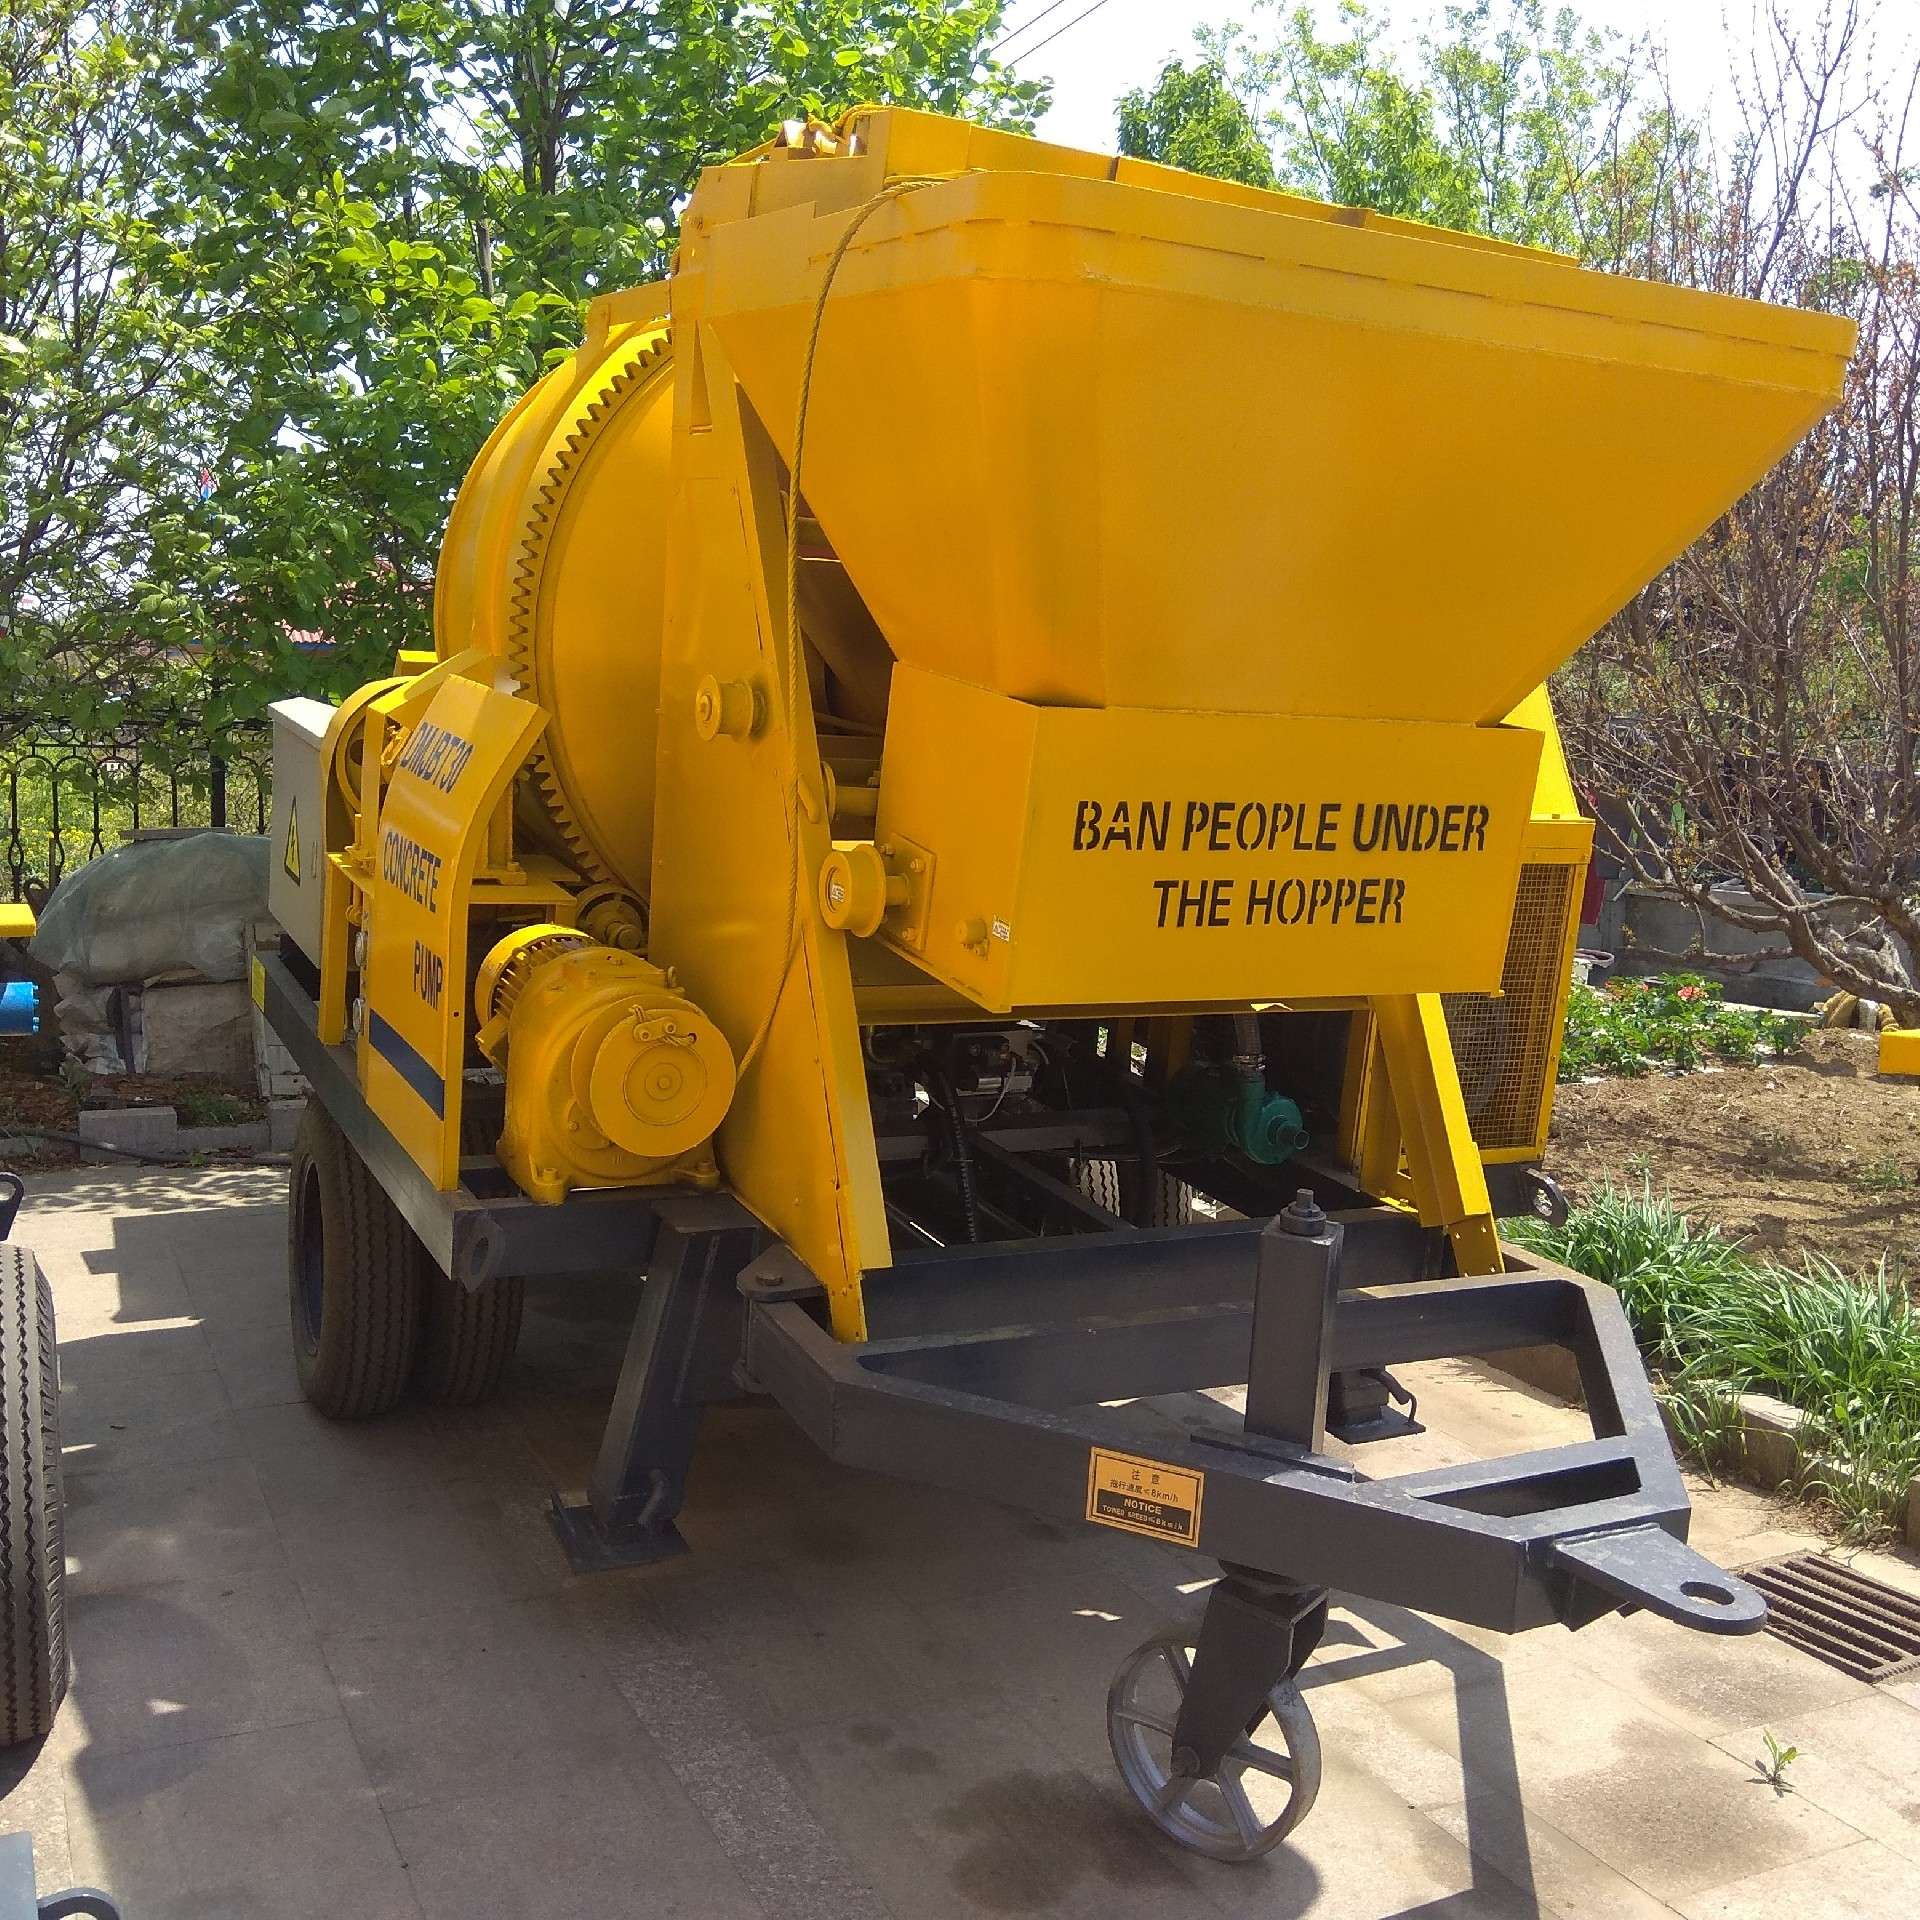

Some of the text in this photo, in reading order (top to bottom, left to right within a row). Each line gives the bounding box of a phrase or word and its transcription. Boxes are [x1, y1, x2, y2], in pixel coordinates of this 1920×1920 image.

[1073, 800, 1490, 852] BAN PEOPLE UNDER
[383, 831, 442, 913] CONCRETE
[1153, 879, 1406, 928] THE HOPPER
[414, 939, 443, 1011] PUMP
[1103, 1504, 1125, 1516] TOWED
[1124, 1498, 1162, 1515] NOTICE
